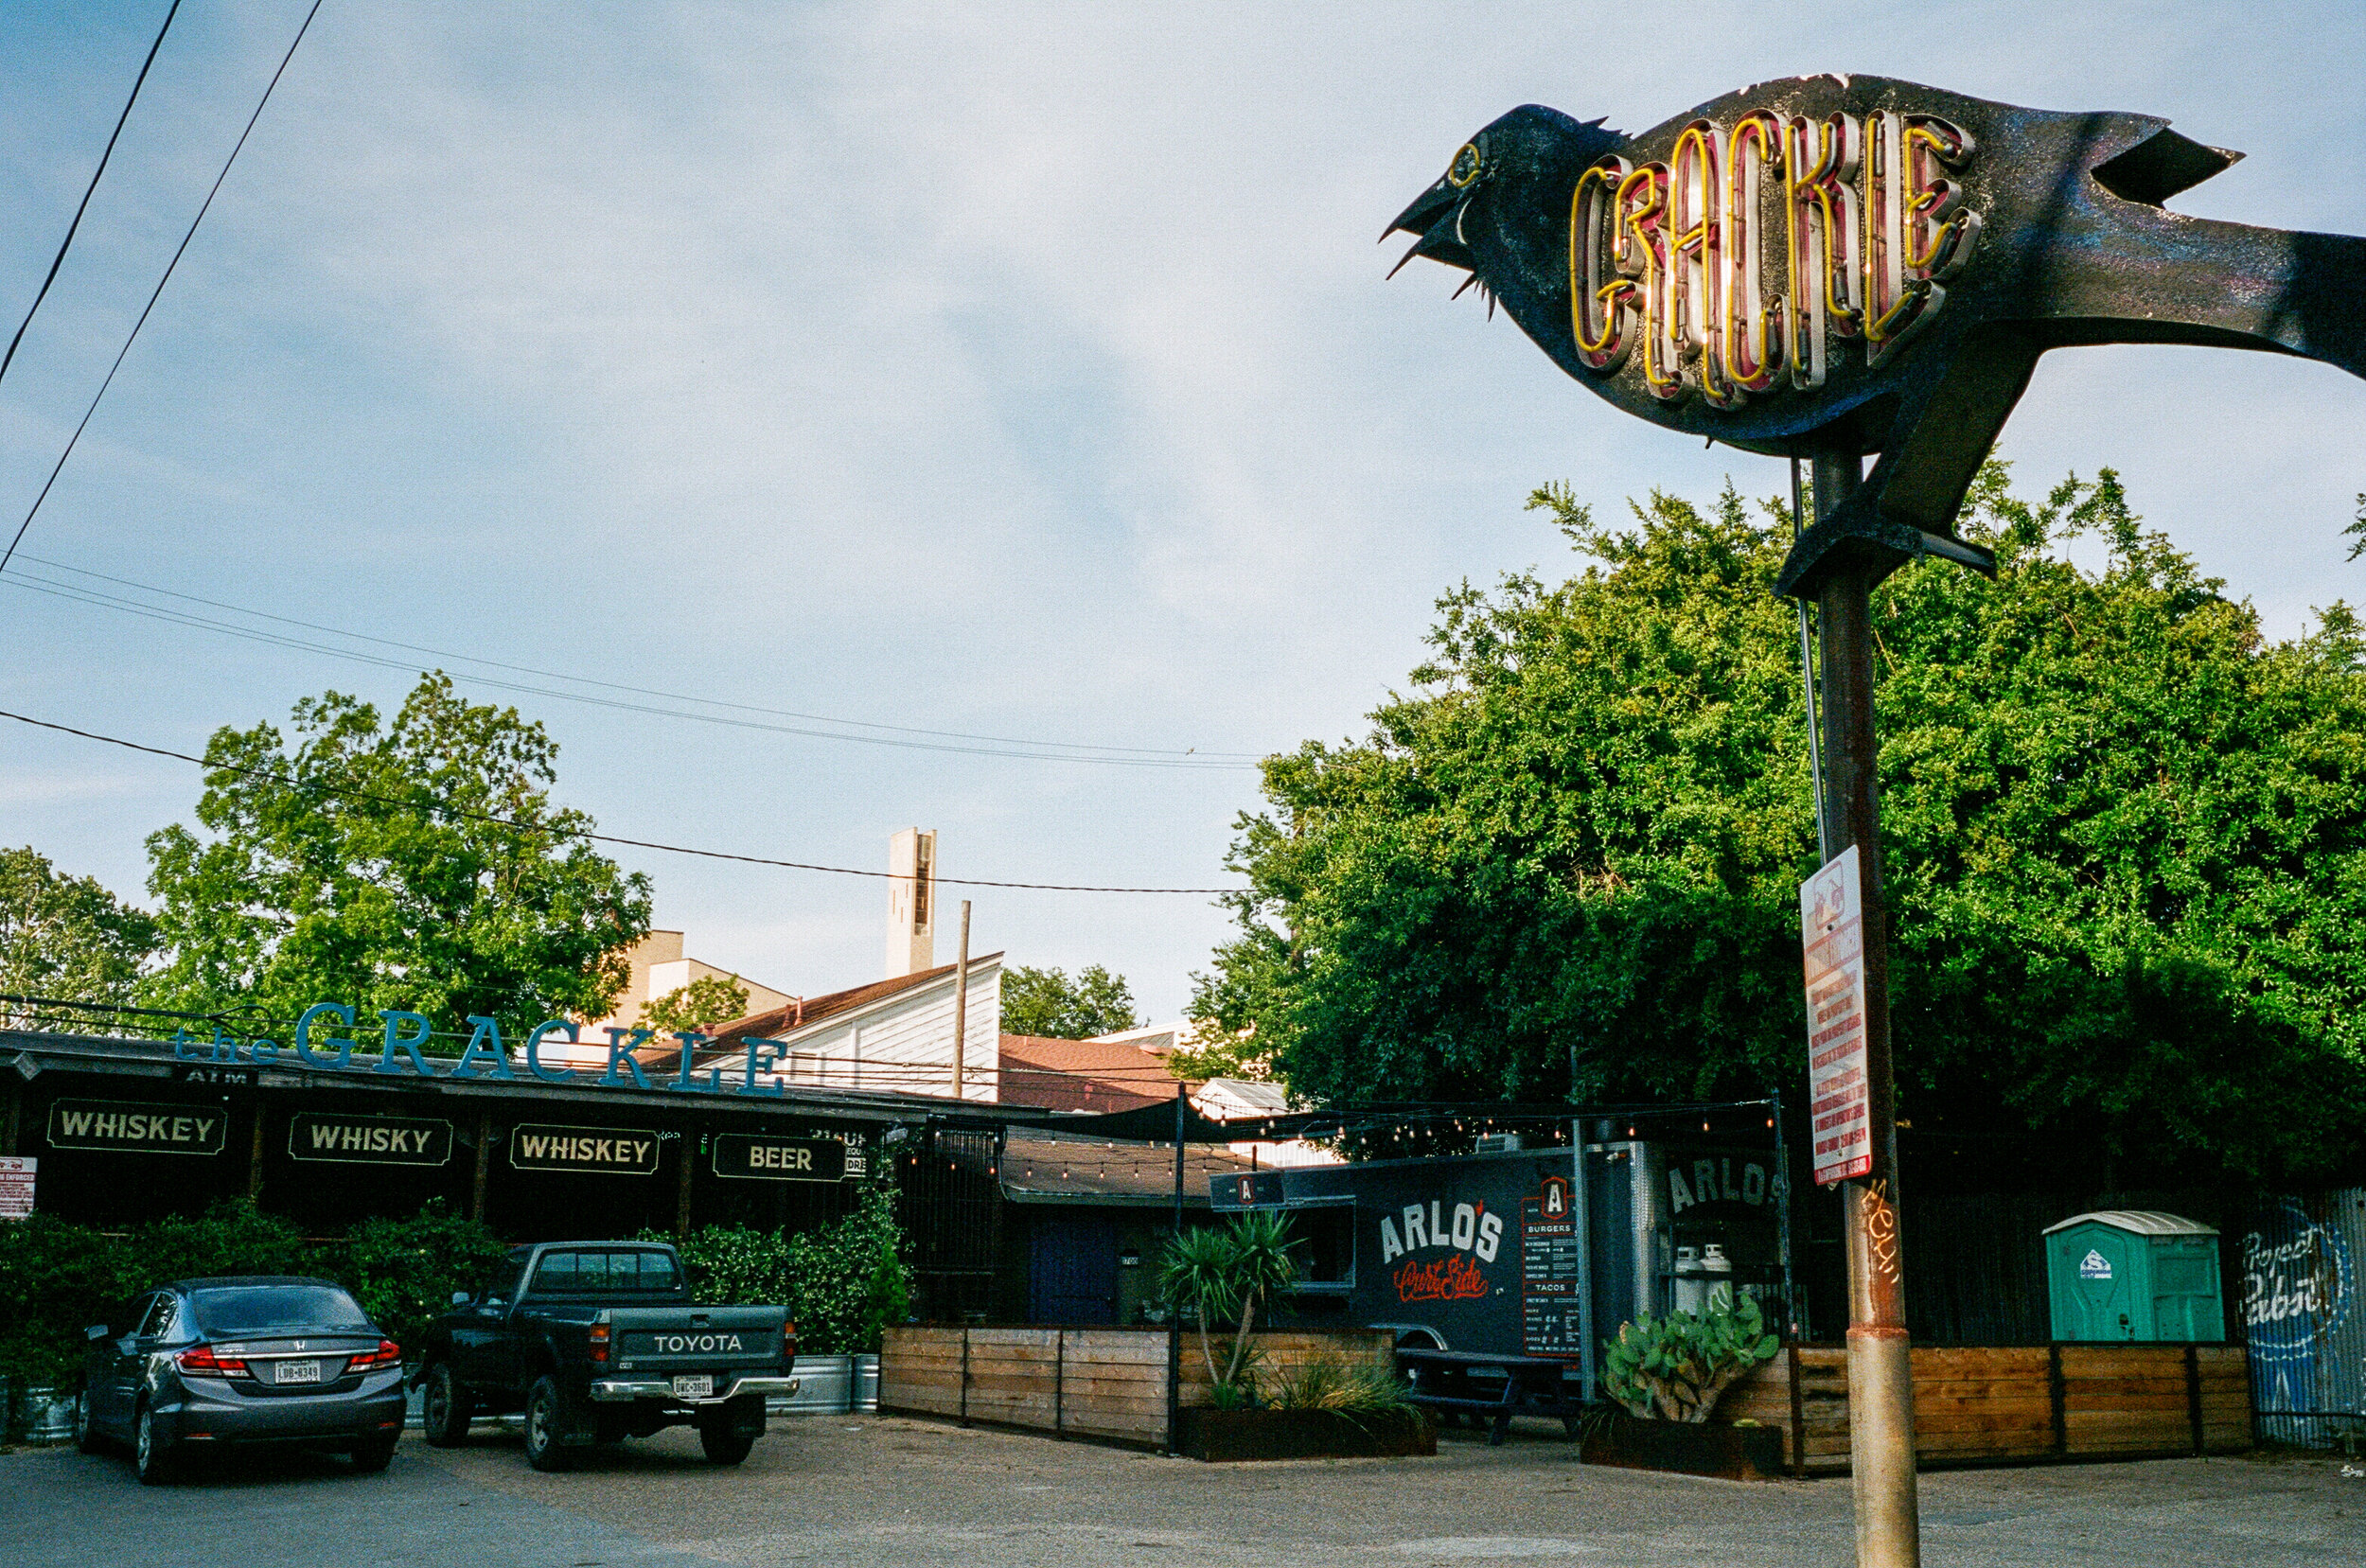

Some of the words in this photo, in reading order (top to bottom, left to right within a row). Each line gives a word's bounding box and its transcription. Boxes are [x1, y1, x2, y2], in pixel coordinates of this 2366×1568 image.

[1569, 108, 1982, 411] GRACKLE
[171, 1027, 278, 1065] the
[295, 1002, 788, 1097] GRACKLE
[186, 1069, 247, 1084] ATM
[62, 1110, 215, 1143] WHISKEY
[310, 1124, 433, 1154] WHISKY
[521, 1134, 651, 1165] WHISKEY
[750, 1145, 814, 1172] BEER
[1381, 1199, 1503, 1264] ARLO'S
[1527, 1224, 1571, 1233] BURGERS
[654, 1334, 742, 1352] TOYOTA
